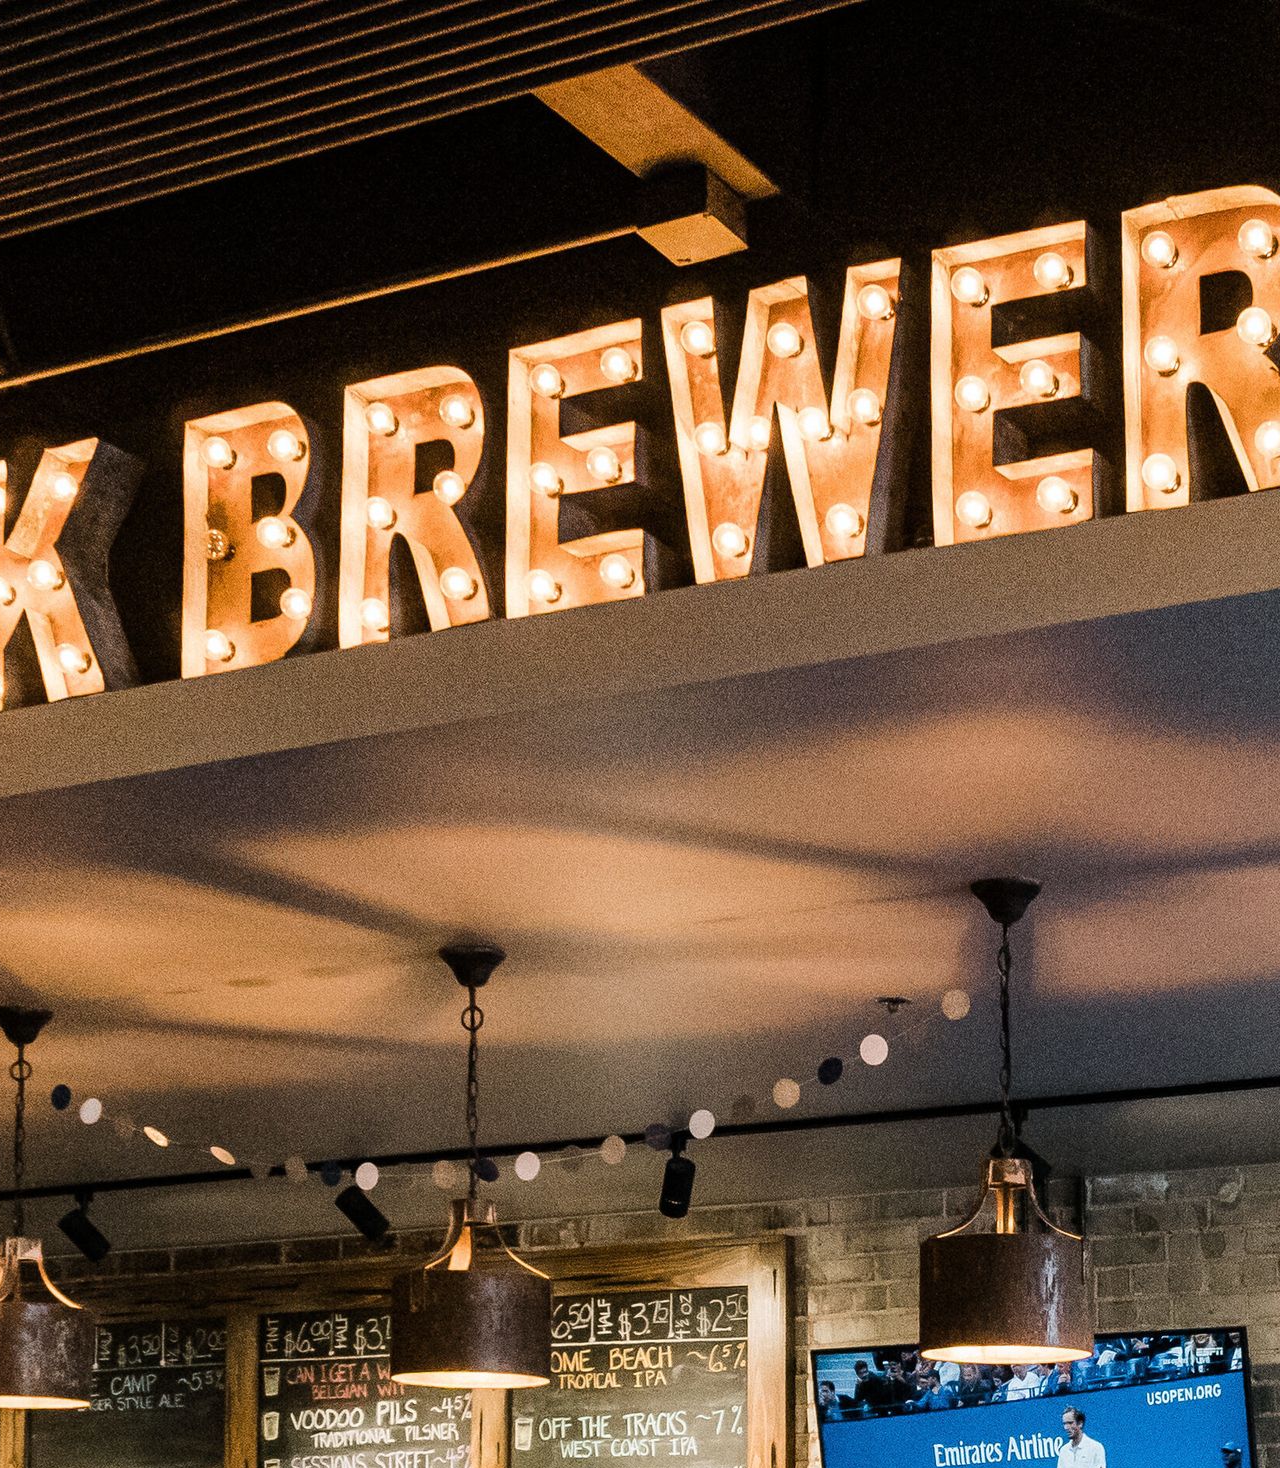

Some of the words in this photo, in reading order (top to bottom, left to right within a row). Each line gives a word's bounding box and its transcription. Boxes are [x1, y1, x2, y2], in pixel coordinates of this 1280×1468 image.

[609, 1345, 673, 1370] BEACH
[311, 1383, 369, 1400] BELGIAN
[559, 1372, 621, 1389] TROPICAL
[633, 1370, 667, 1388] IPA
[1146, 1383, 1222, 1406] USOPEN.ORG
[290, 1407, 365, 1431] VOODOO
[376, 1399, 418, 1426] PILS
[538, 1417, 572, 1441] OFF
[577, 1414, 613, 1439] THE
[622, 1410, 688, 1437] TRACKS
[310, 1427, 395, 1450] TRADITIONAL
[405, 1422, 460, 1442] PILSNER
[560, 1439, 605, 1459] WEST
[610, 1438, 659, 1457] COAST
[668, 1436, 698, 1457] IPA
[933, 1440, 1003, 1468] Emirates
[1007, 1432, 1064, 1462] Airline
